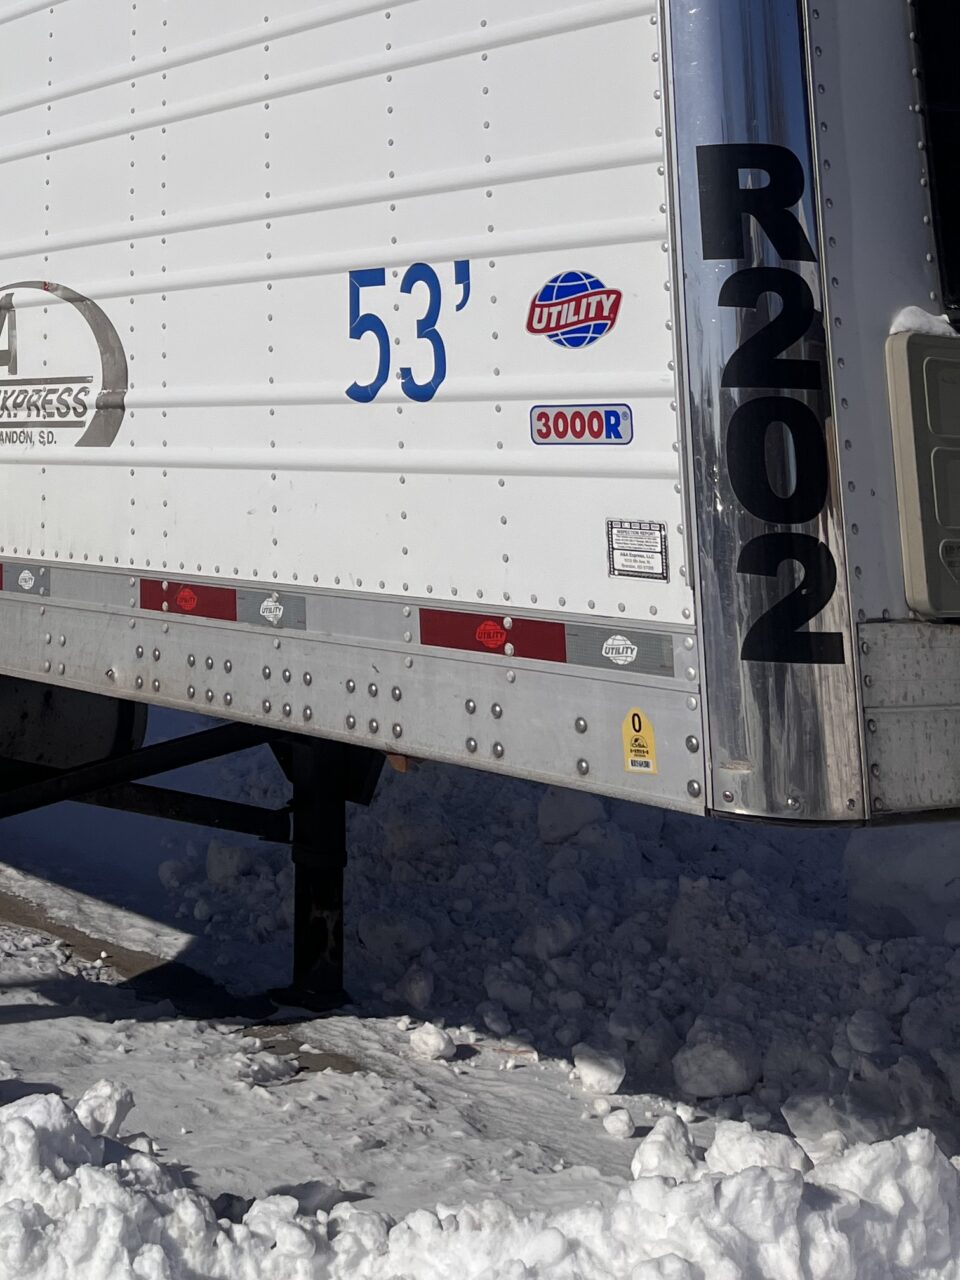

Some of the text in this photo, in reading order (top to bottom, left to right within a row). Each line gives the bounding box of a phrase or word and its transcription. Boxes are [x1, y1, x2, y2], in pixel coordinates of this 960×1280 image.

[532, 293, 617, 330] UTILITY
[695, 143, 846, 665] R202
[261, 606, 282, 615] UTILITY
[604, 645, 636, 657] UTILITY
